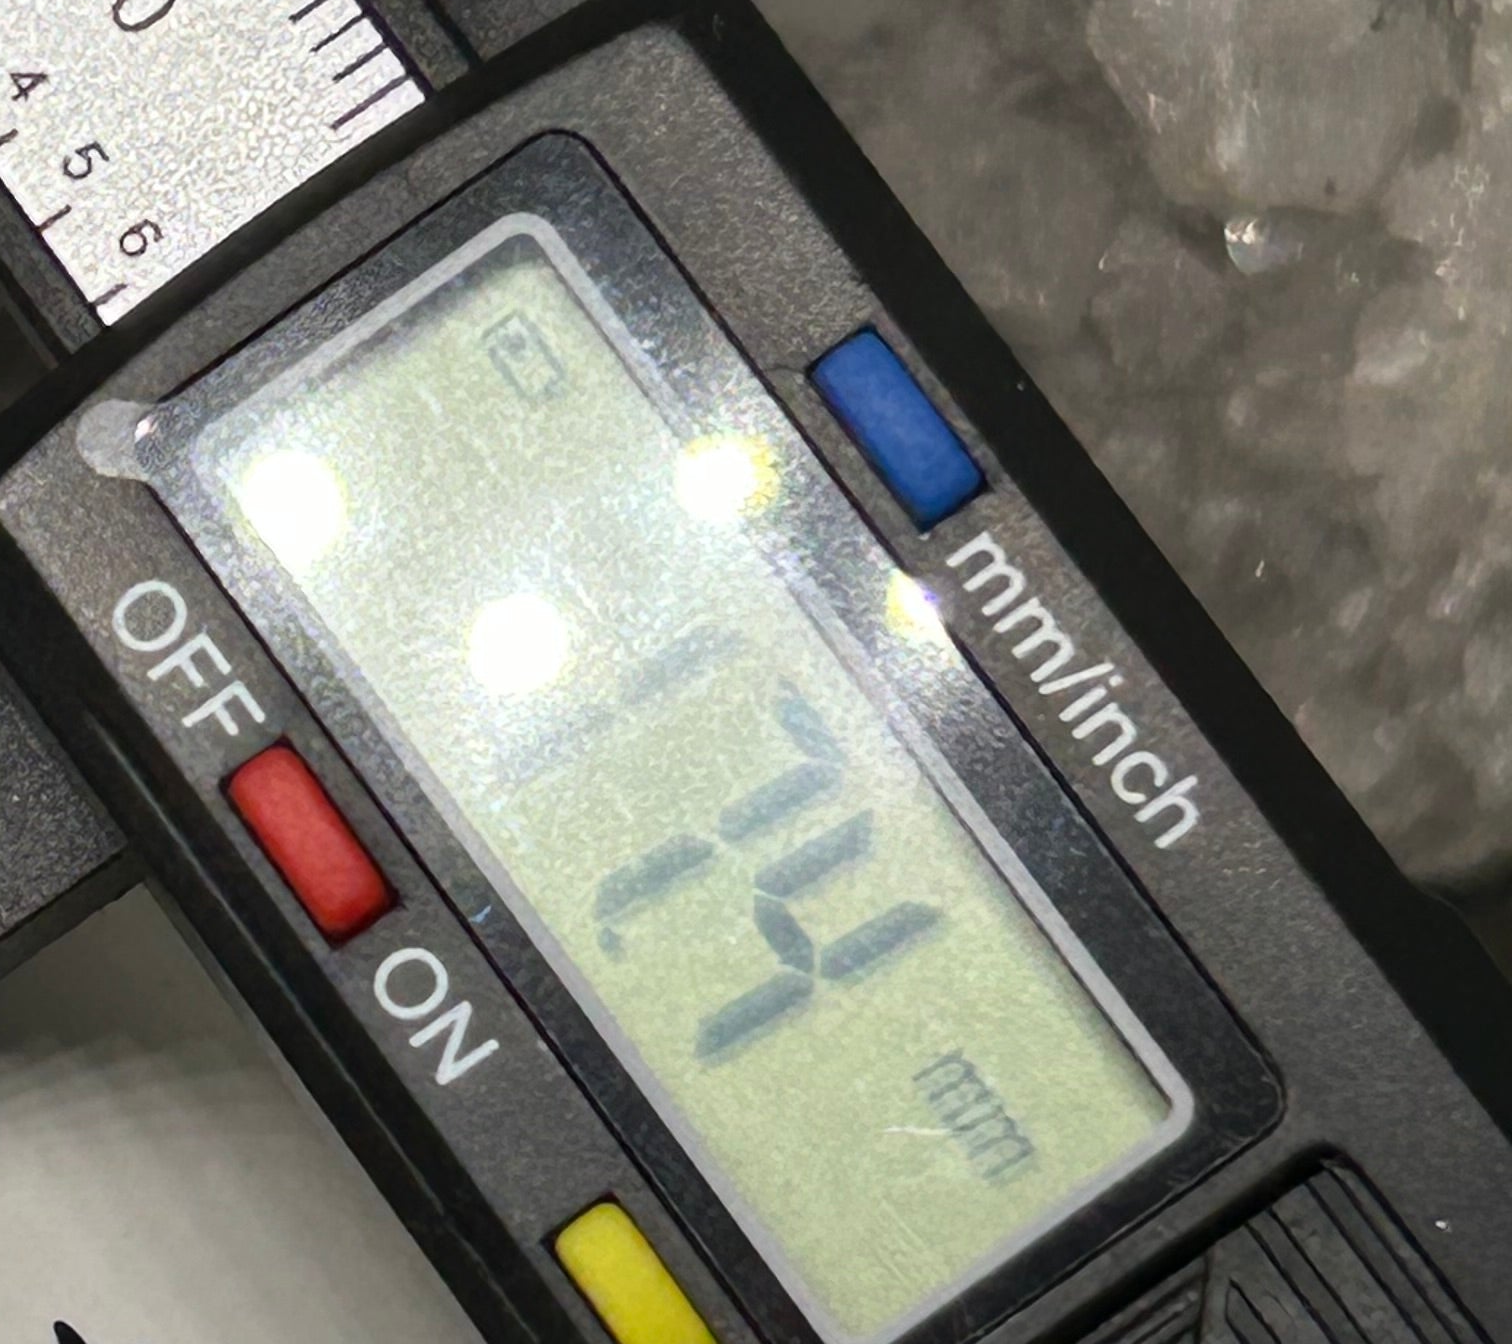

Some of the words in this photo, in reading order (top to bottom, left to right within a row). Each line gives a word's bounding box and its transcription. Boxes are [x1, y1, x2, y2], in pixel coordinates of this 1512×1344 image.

[9, 71, 49, 102] 4
[61, 141, 110, 181] 5
[118, 218, 165, 257] 6
[111, 579, 267, 738] OFF
[944, 530, 1201, 850] mm/inch
[372, 946, 501, 1086] ON
[910, 1046, 1037, 1186] mm
